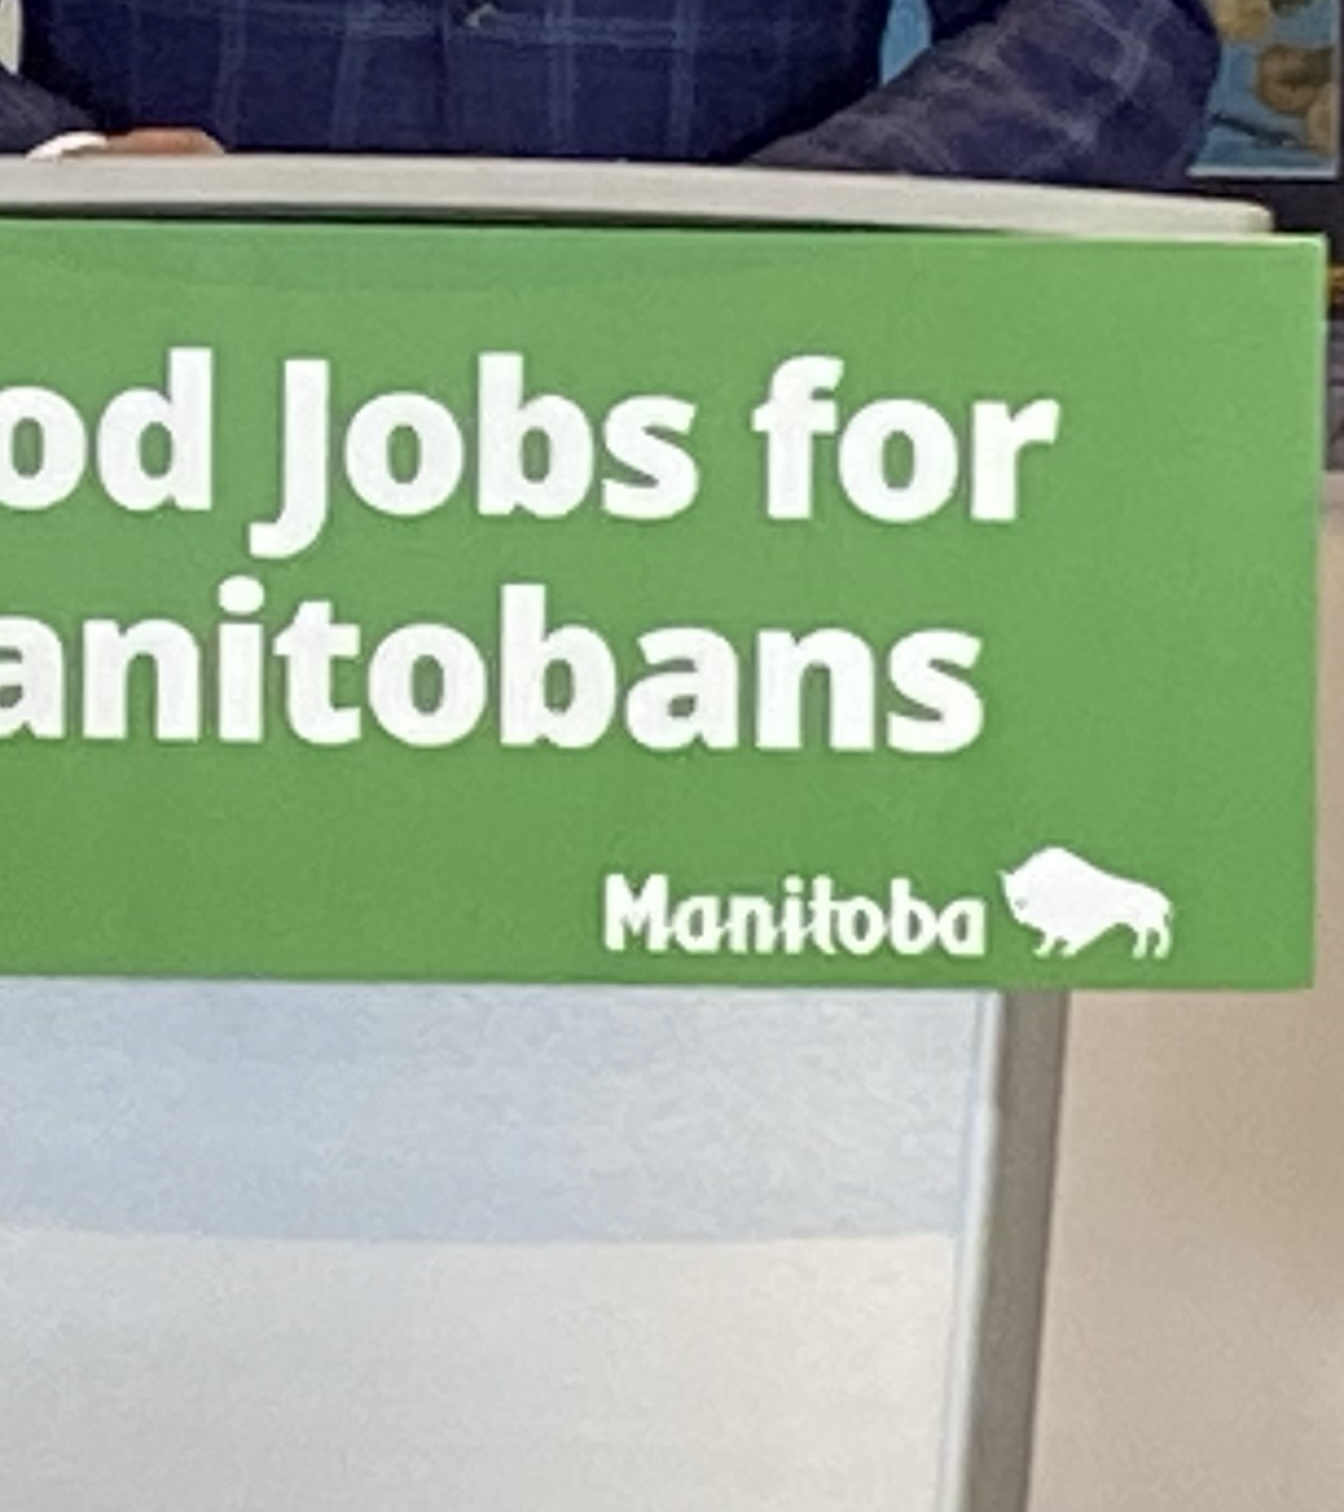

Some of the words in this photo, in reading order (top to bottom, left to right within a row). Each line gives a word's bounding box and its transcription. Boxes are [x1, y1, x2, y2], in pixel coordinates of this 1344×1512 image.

[246, 355, 702, 562] Jobs
[749, 352, 1062, 524] for
[602, 872, 988, 958] Manitoba
